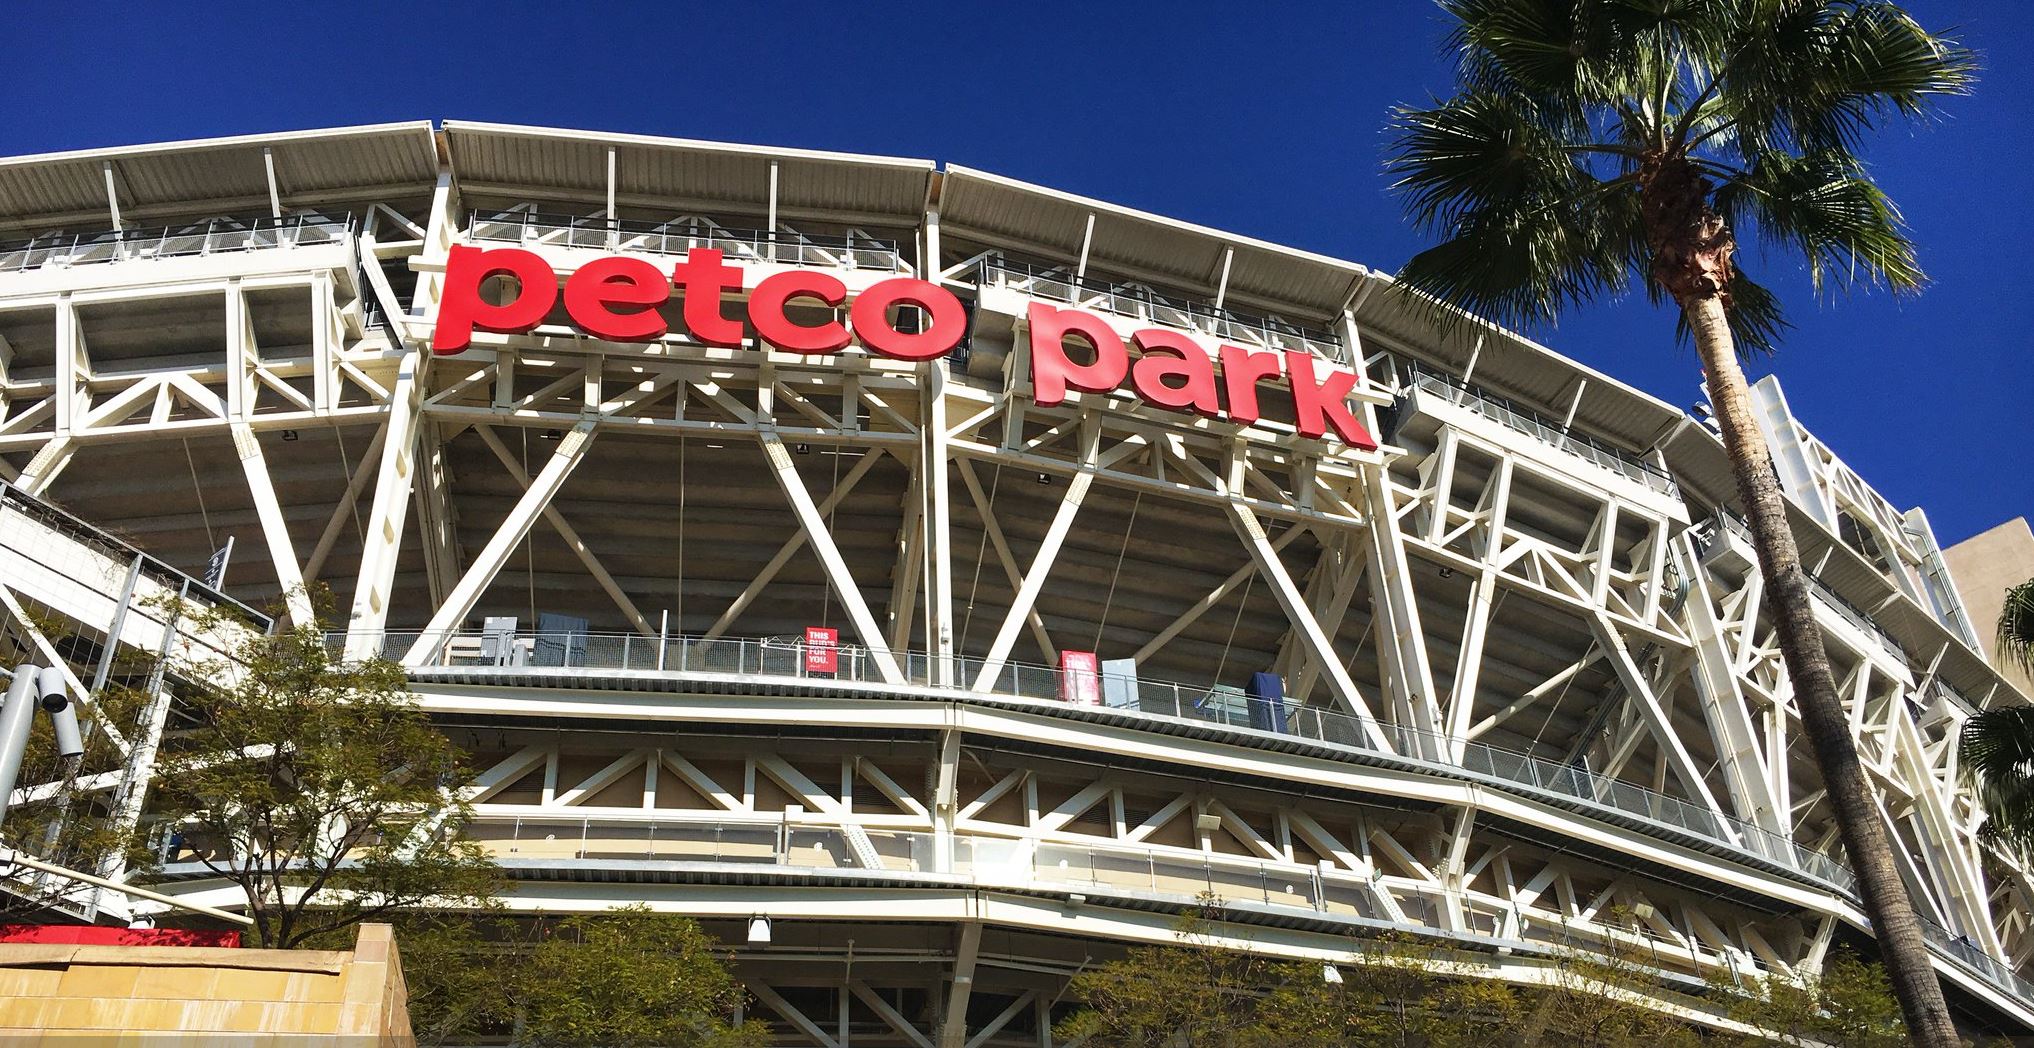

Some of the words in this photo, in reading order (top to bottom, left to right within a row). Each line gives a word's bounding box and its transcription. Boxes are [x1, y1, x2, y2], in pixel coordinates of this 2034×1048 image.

[433, 243, 967, 361] petco
[1027, 300, 1377, 450] park
[809, 631, 829, 640] THIS
[809, 647, 827, 656] FOR
[809, 656, 829, 664] YOU.
